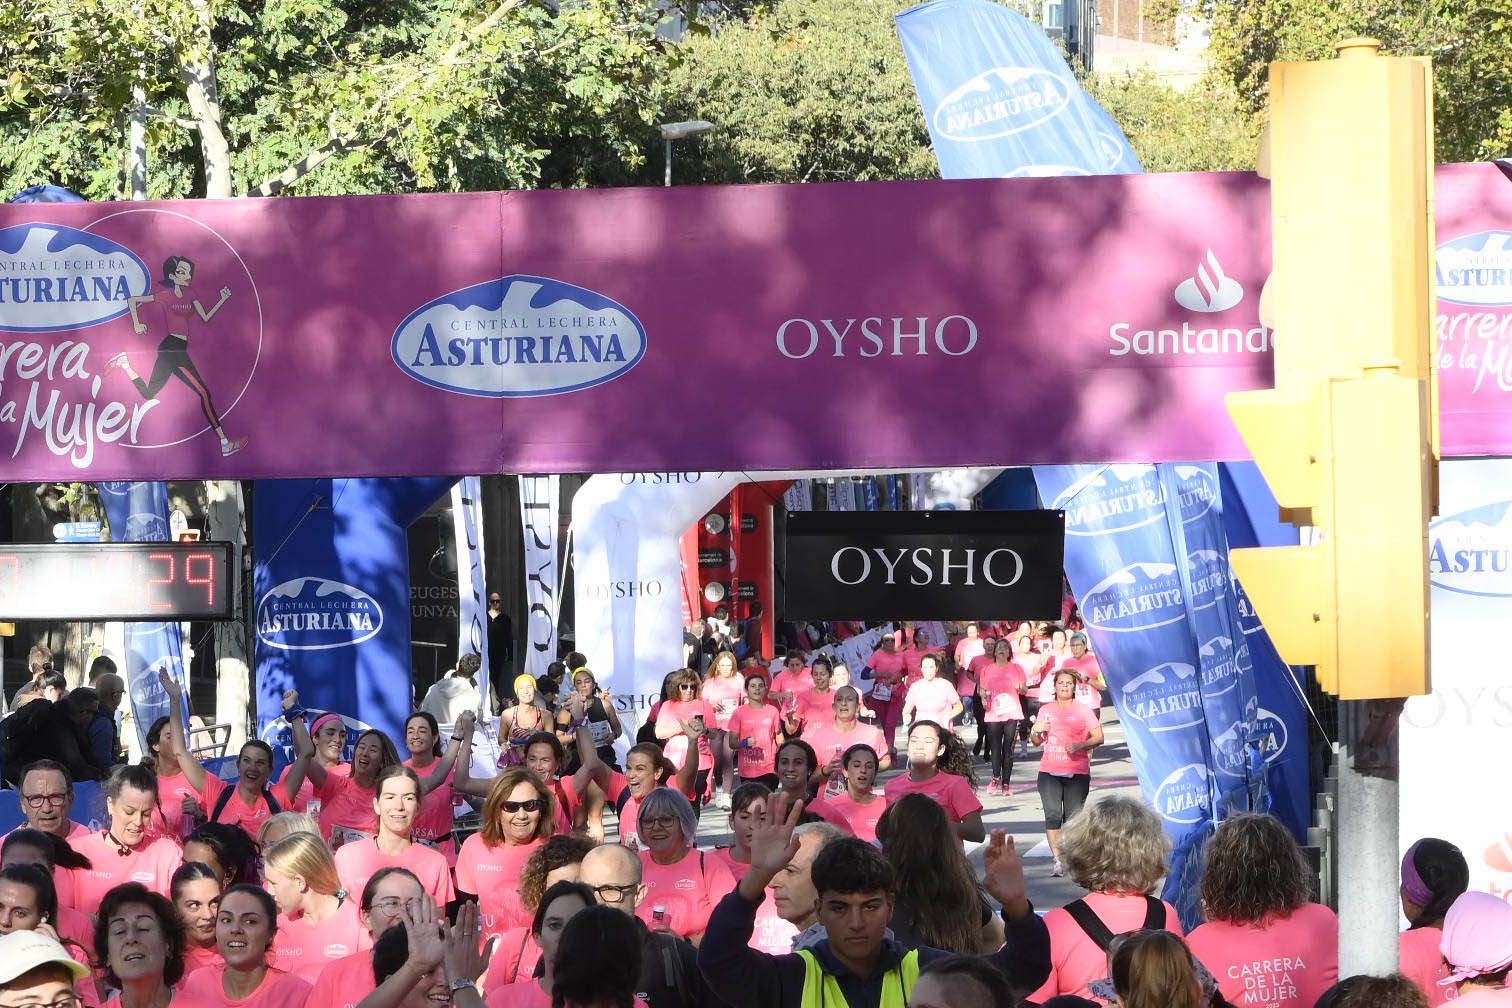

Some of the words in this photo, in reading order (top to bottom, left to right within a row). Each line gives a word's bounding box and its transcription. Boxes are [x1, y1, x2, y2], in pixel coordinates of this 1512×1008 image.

[54, 258, 126, 271] LECHERA
[451, 318, 529, 331] CENTRAL
[538, 316, 617, 329] LECHERA
[412, 323, 628, 367] ASTURIANA
[776, 315, 979, 359] OYSHO
[1109, 322, 1275, 356] Santand
[11, 374, 161, 470] Mujer
[831, 546, 1024, 587] OYSHO
[409, 587, 458, 599] EUGES
[585, 580, 662, 600] OYSHO
[273, 602, 316, 611] CENTRAL
[320, 601, 369, 610] LECHERA
[412, 606, 457, 618] UNYA
[261, 606, 374, 634] ASTURIANA
[1227, 955, 1306, 980] CARRERA
[1245, 976, 1267, 991] DE
[1272, 973, 1294, 988] LA
[1243, 985, 1298, 1005] MUJER
